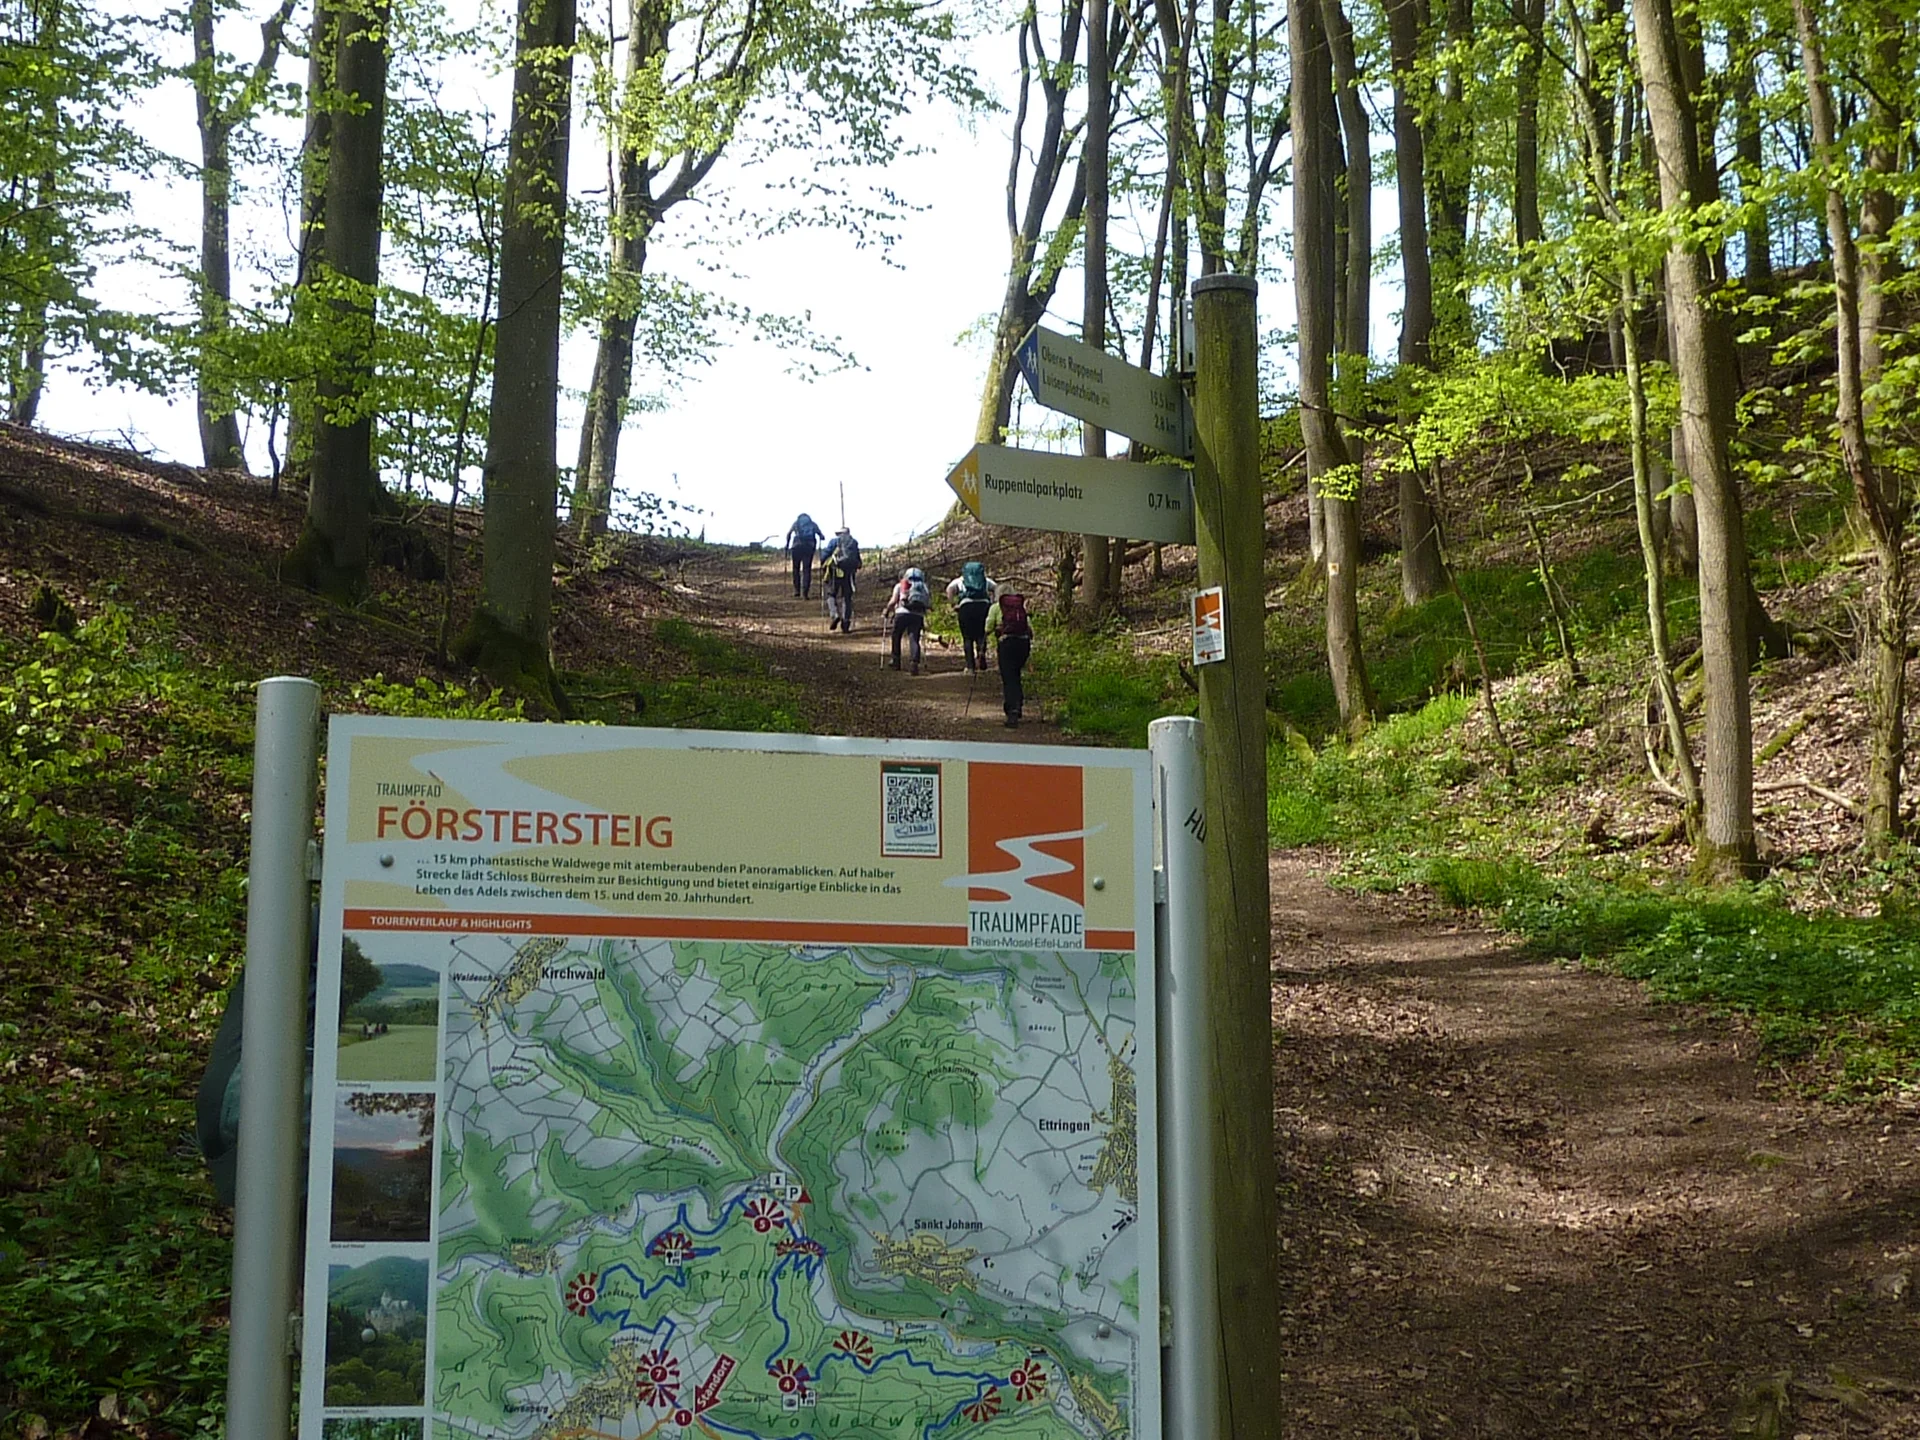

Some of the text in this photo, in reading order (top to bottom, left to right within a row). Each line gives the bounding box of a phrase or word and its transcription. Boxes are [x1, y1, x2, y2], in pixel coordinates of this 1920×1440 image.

[1068, 355, 1103, 385] Ruppental
[984, 473, 1083, 501] Ruppentalparkplatz
[1148, 493, 1181, 511] 0,7 km
[375, 782, 442, 798] TRAUMPFAD
[376, 799, 674, 849] FÖRSTERSTEIG
[433, 854, 447, 864] 15
[449, 855, 468, 865] km
[470, 854, 549, 869] phantastische
[552, 857, 611, 872] Waldwege
[613, 859, 632, 870] mit
[634, 859, 737, 874] atemberaubenden
[740, 864, 837, 878] Panoramablicken.
[839, 867, 859, 878] Auf
[860, 867, 895, 879] halber
[416, 868, 902, 894] Strecke lädt Schloss Bürresheim zur Besichtigung und bietet einzigartige Einblicke in das
[415, 884, 754, 905] Leben des Adels zwischen dem 15. und dem 20. Jahrhundert.
[370, 915, 533, 931] TOURENVERLAUF & HIGHLIGHTS
[969, 910, 1083, 936] TRAUMPFADE
[970, 937, 1083, 949] Rhein-Mosel-Eifel-Land
[541, 966, 606, 981] Kirchwald
[1038, 1119, 1090, 1132] Ettringen
[789, 1187, 799, 1198] P
[759, 1219, 766, 1229] 5
[914, 1218, 983, 1230] Sankt Johann
[583, 1290, 590, 1300] 6
[656, 1369, 663, 1379] 7
[697, 1358, 732, 1407] Standort
[783, 1379, 791, 1390] 4
